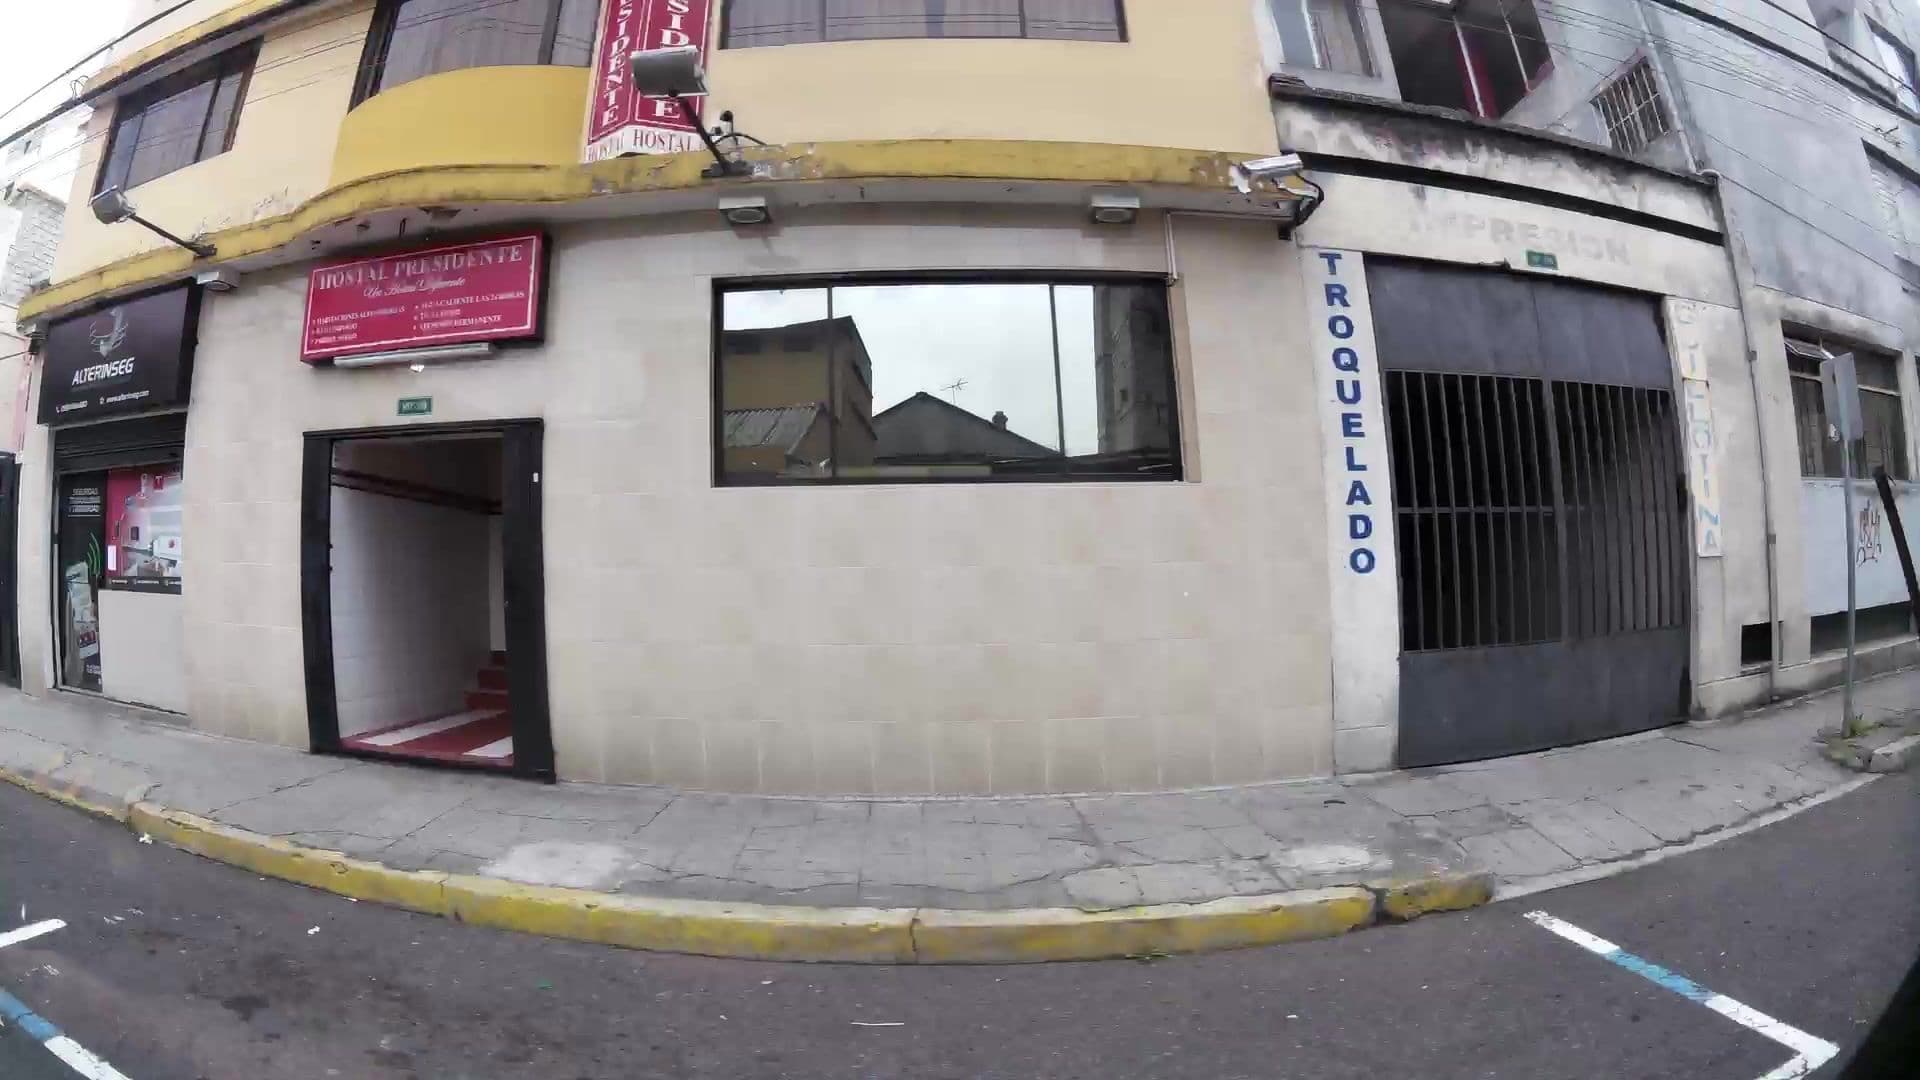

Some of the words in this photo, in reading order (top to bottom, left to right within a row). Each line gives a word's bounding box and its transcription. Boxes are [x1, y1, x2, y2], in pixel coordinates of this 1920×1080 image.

[319, 261, 389, 290] HOSTAL
[394, 245, 524, 278] PRESIDENTE
[71, 356, 135, 386] ALTERINSEG
[1318, 252, 1376, 575] TROQUELADO
